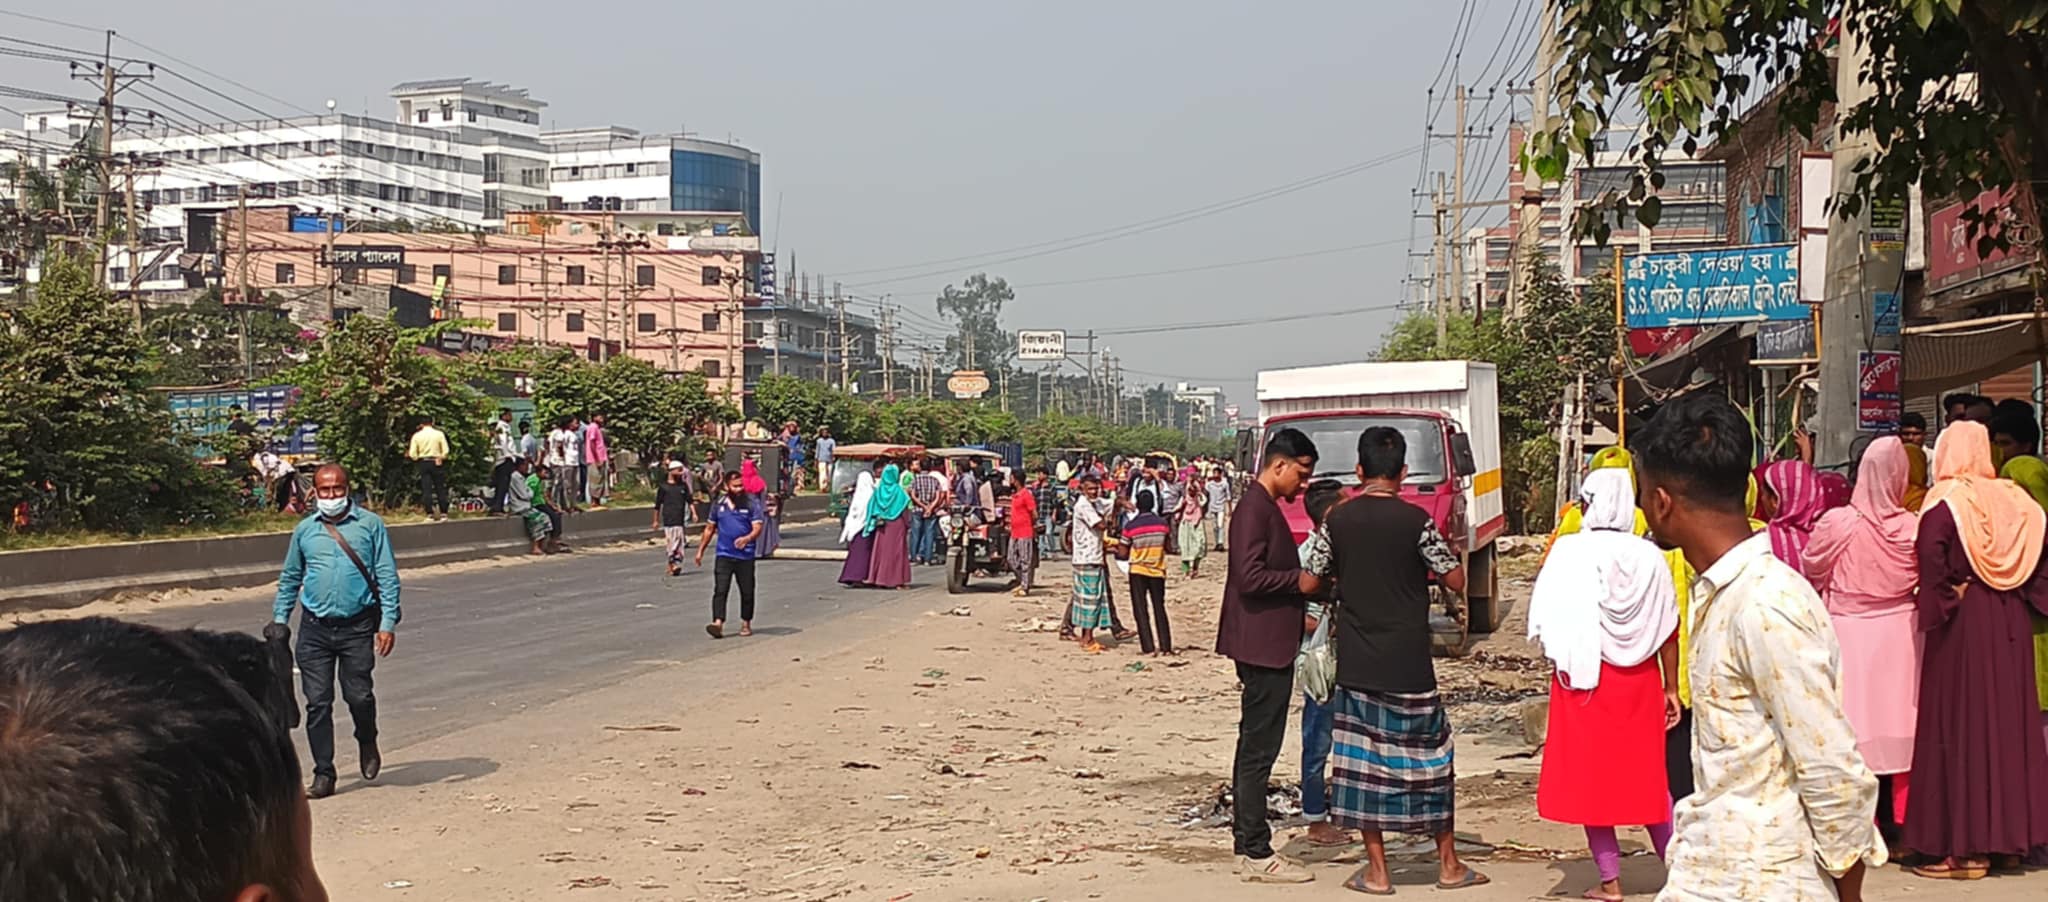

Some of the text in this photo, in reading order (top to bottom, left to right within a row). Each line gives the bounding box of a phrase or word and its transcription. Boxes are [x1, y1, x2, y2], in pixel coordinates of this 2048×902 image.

[1647, 253, 1693, 279] চাকুরী
[1699, 253, 1744, 273] দেওয়া
[1750, 252, 1774, 272] হয়
[1628, 286, 1650, 315] S.S.
